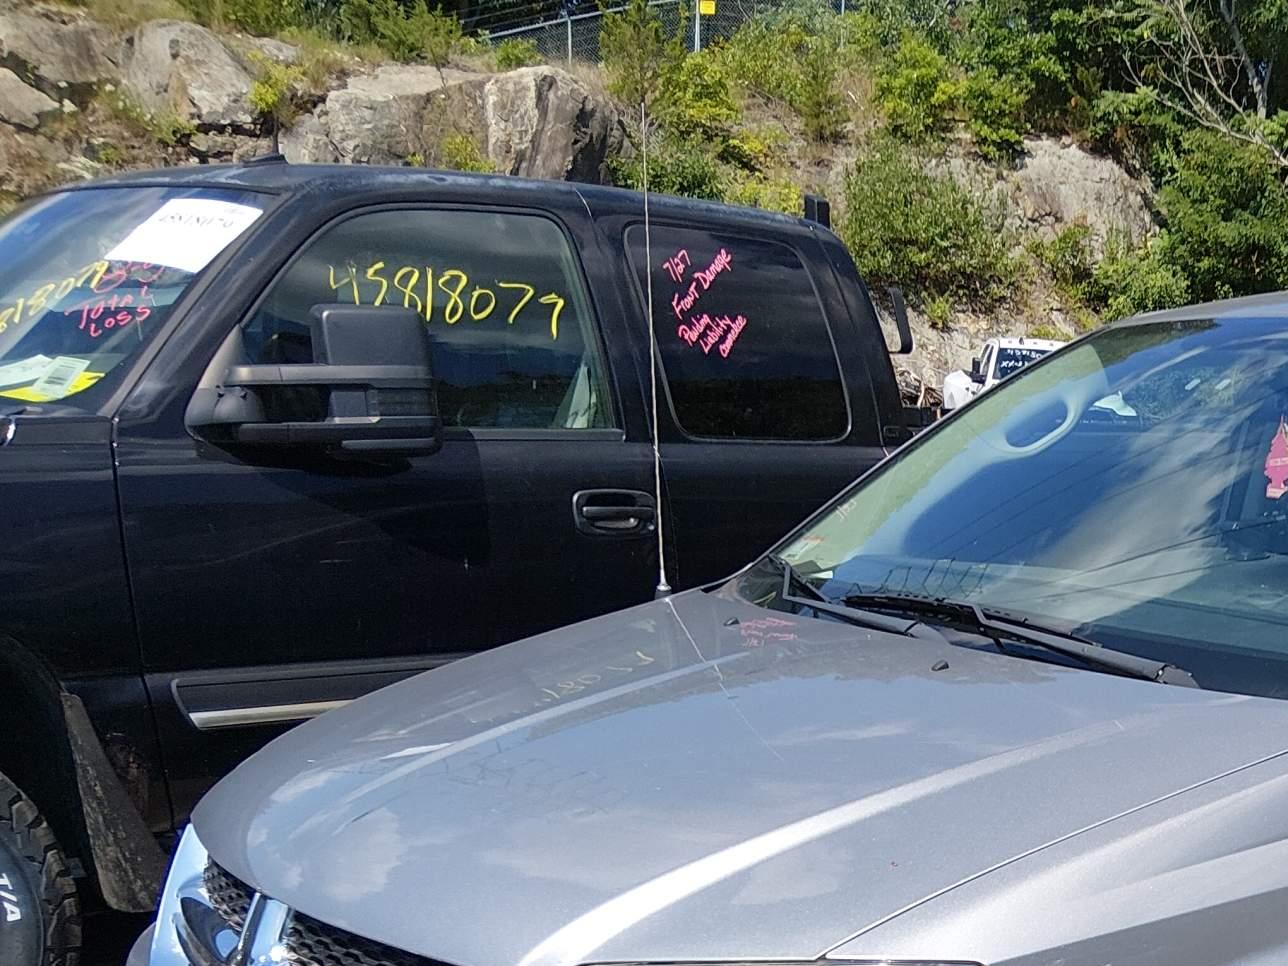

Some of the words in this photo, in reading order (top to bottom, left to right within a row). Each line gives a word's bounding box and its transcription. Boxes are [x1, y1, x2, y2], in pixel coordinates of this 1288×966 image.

[663, 249, 691, 283] 7/27
[694, 248, 732, 290] Damage
[329, 259, 565, 341] 45818079
